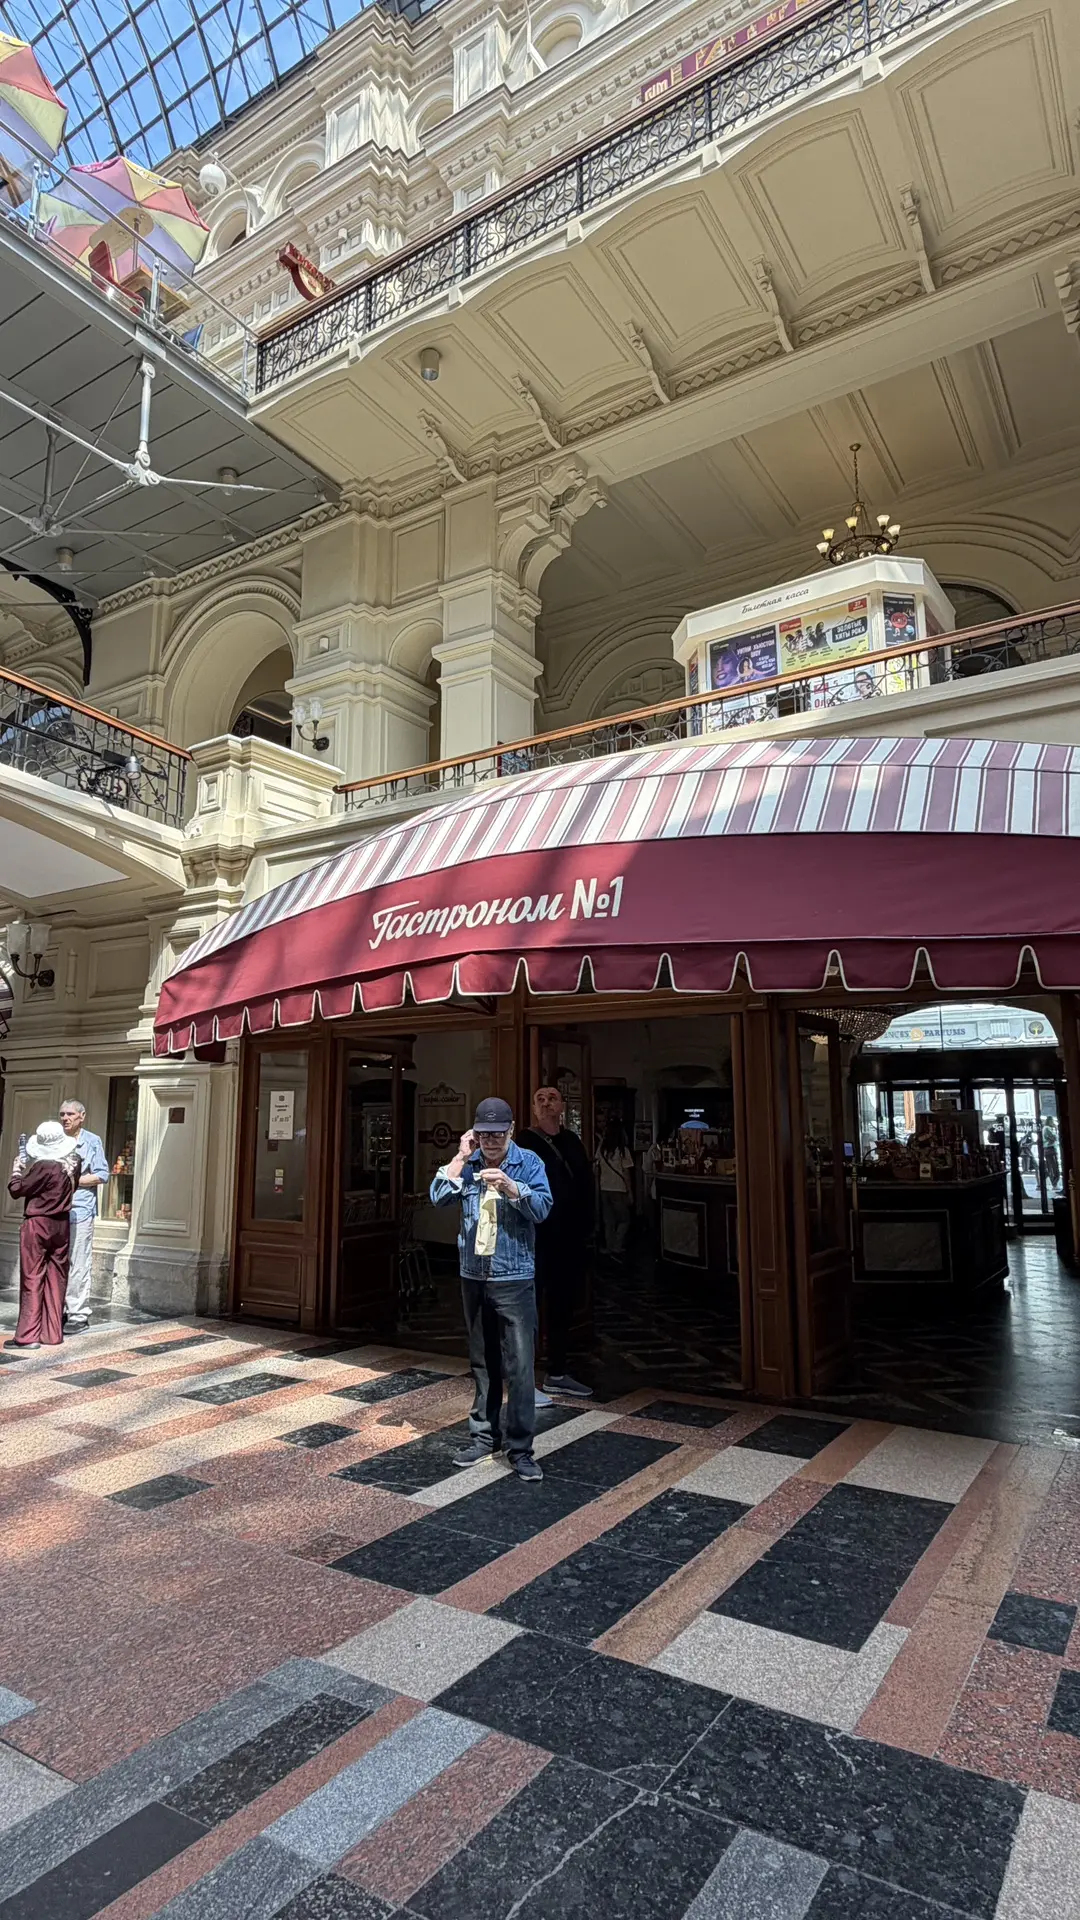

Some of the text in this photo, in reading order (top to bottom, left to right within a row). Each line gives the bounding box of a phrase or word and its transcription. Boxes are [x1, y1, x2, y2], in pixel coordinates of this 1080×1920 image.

[741, 588, 809, 614] Билетная касса
[836, 620, 862, 633] ЗОЛОТЫЕ
[851, 626, 866, 637] РОКА
[369, 876, 624, 950] Гастроном №1
